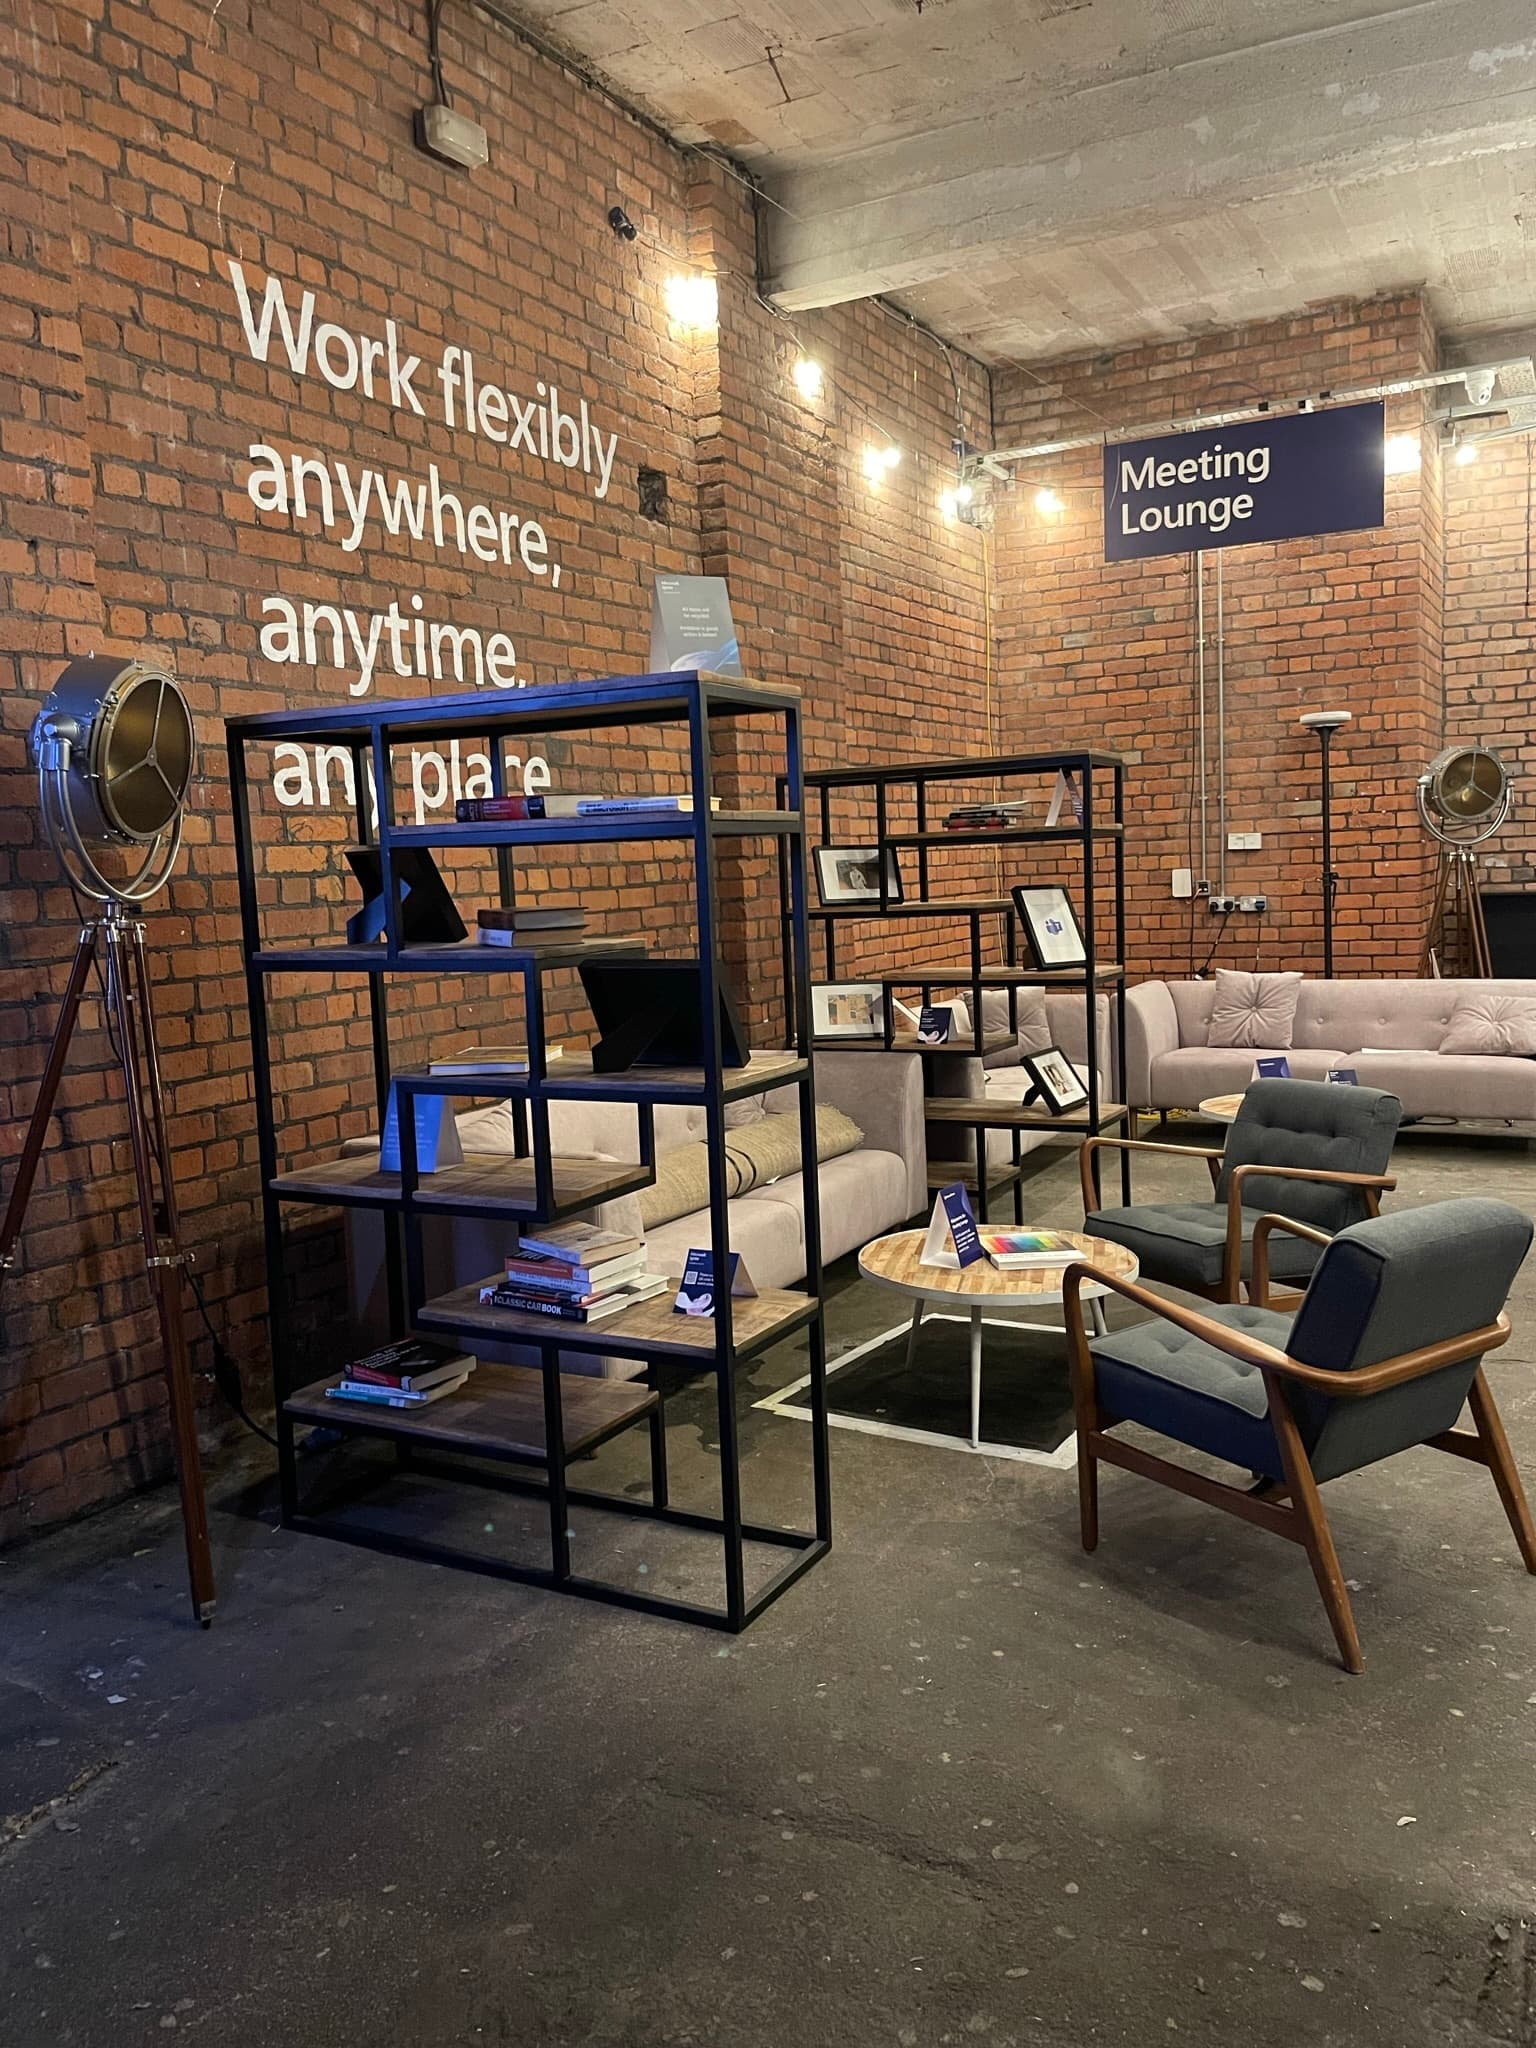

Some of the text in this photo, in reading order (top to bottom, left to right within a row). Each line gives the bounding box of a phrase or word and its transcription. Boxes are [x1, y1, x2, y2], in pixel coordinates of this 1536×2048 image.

[228, 259, 617, 498] Work flexibly
[1121, 444, 1270, 493] Meeting
[248, 443, 562, 588] anywhere,
[1122, 494, 1254, 535] Lounge
[259, 594, 526, 696] anytime,
[541, 1303, 562, 1315] BOOK
